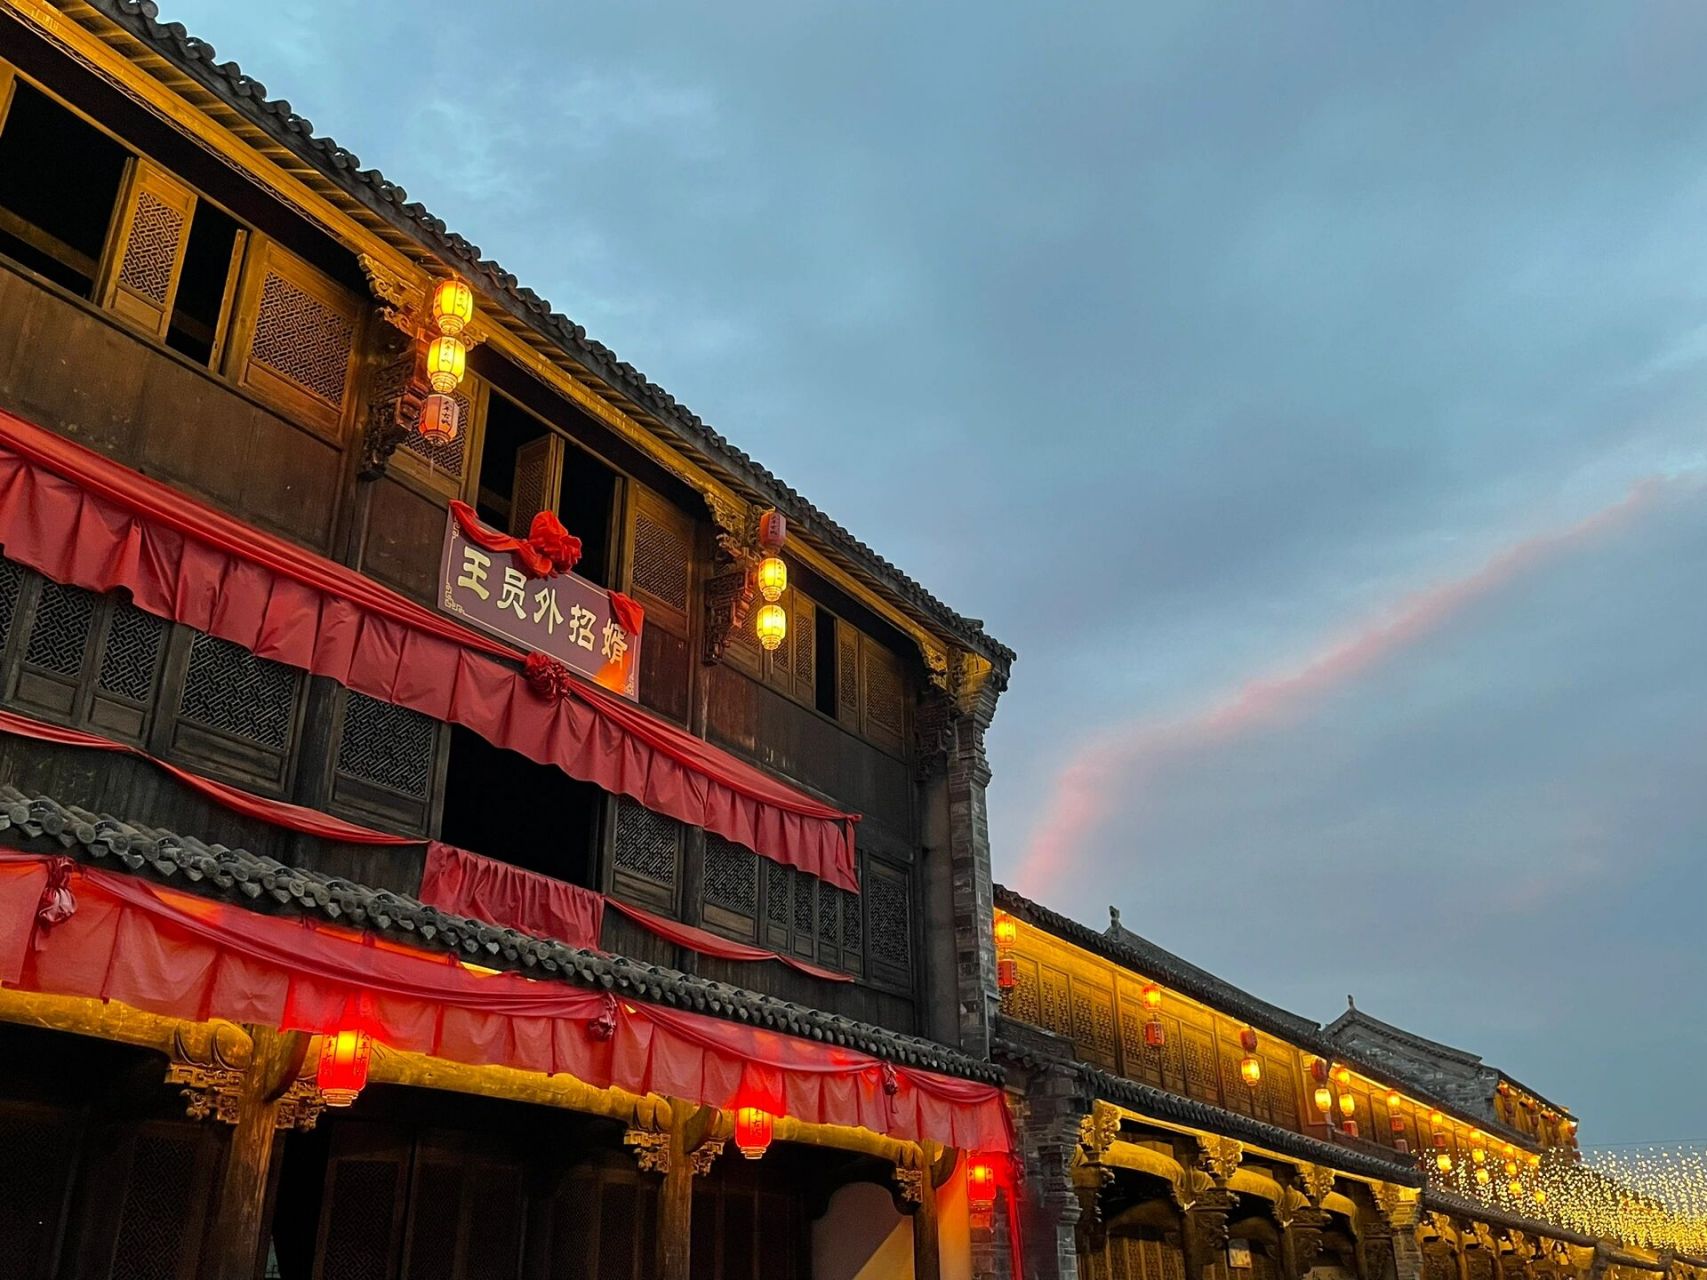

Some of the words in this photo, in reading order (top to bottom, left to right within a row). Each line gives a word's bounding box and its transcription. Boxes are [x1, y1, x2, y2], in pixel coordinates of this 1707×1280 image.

[457, 546, 628, 669] 王员外招婿
